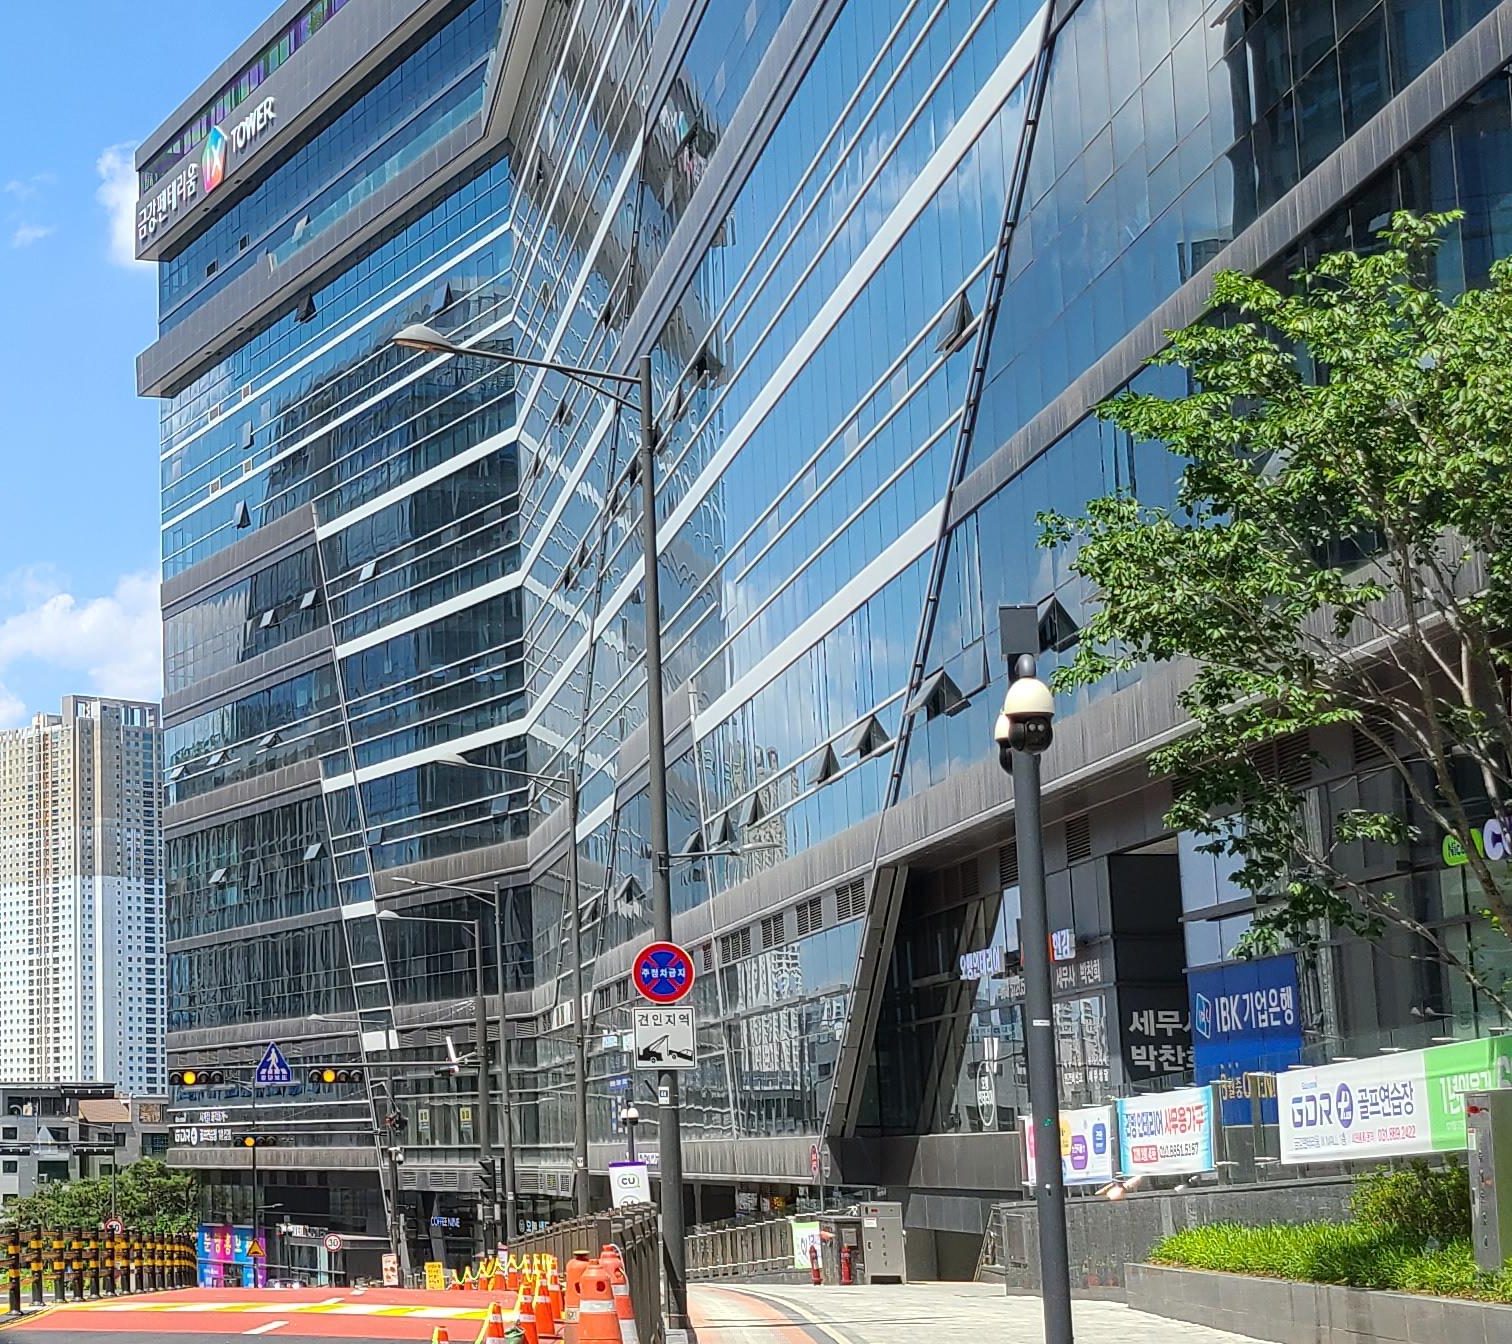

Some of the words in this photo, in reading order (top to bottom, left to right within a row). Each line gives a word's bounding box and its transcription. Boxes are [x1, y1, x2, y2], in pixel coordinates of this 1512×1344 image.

[137, 162, 199, 241] 금강펜테리움
[230, 96, 277, 153] TOWER
[641, 967, 686, 979] 주정차금지
[638, 1013, 690, 1026] 견인지역
[1357, 1080, 1414, 1121] 골프연습장
[621, 1177, 635, 1185] CU
[328, 1238, 338, 1247] 30
